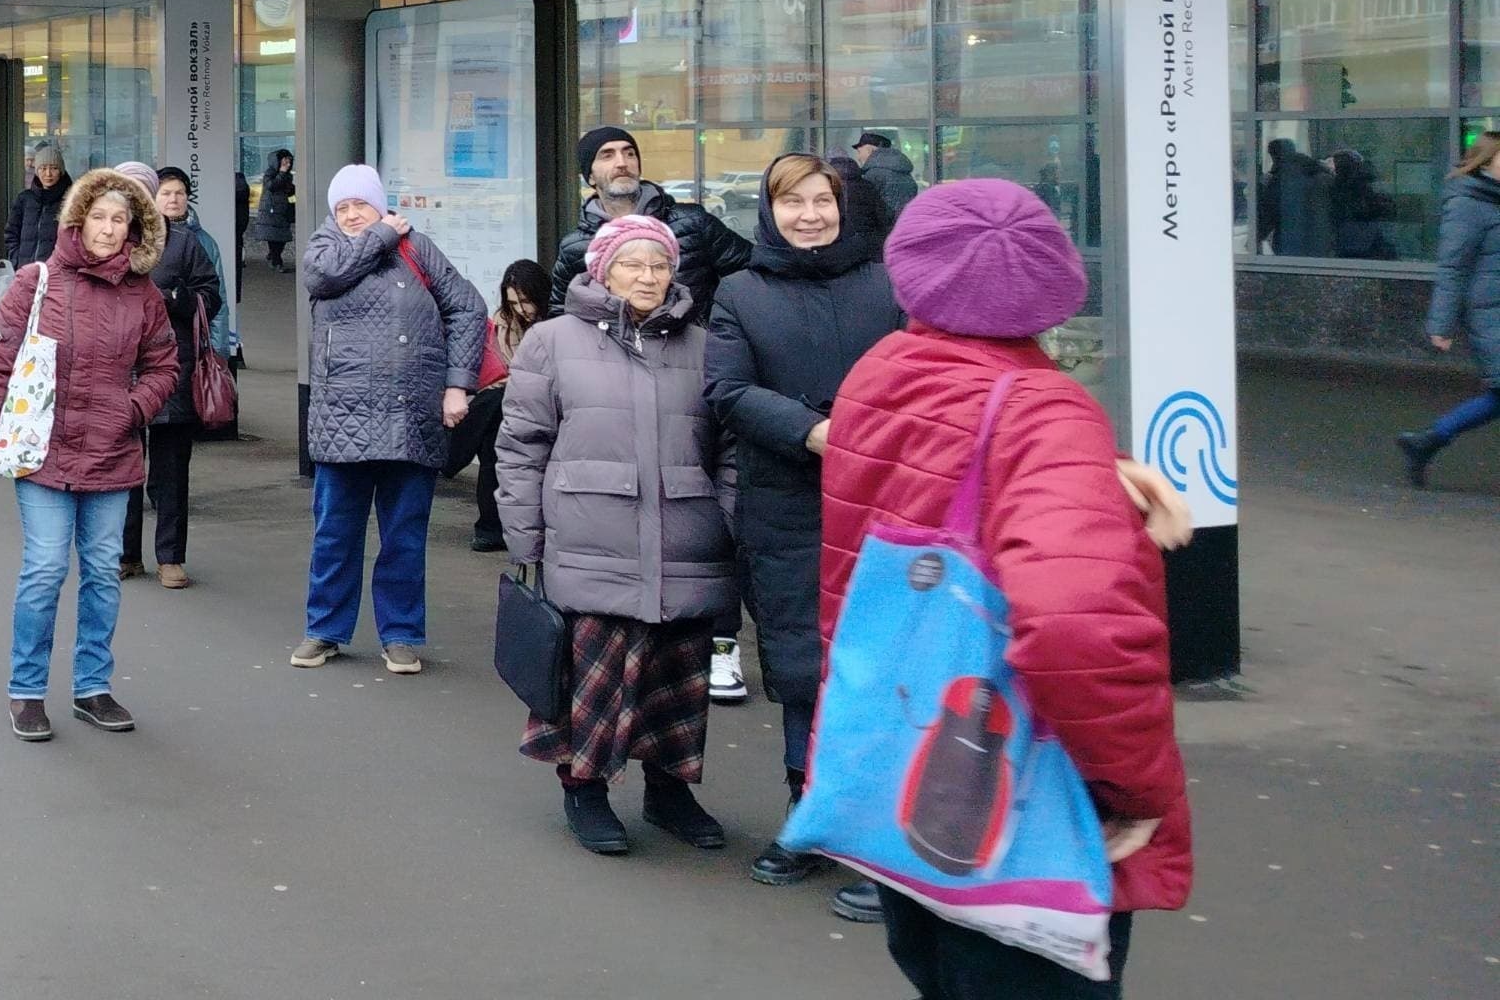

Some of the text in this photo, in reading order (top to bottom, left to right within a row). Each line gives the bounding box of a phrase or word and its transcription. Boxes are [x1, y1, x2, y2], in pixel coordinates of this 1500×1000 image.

[203, 21, 212, 131] Metro Rechnoy Vokzal
[1159, 12, 1176, 132] «Речной
[1182, 39, 1194, 97] Metro
[189, 152, 201, 206] Метро
[1162, 141, 1181, 241] Метро
